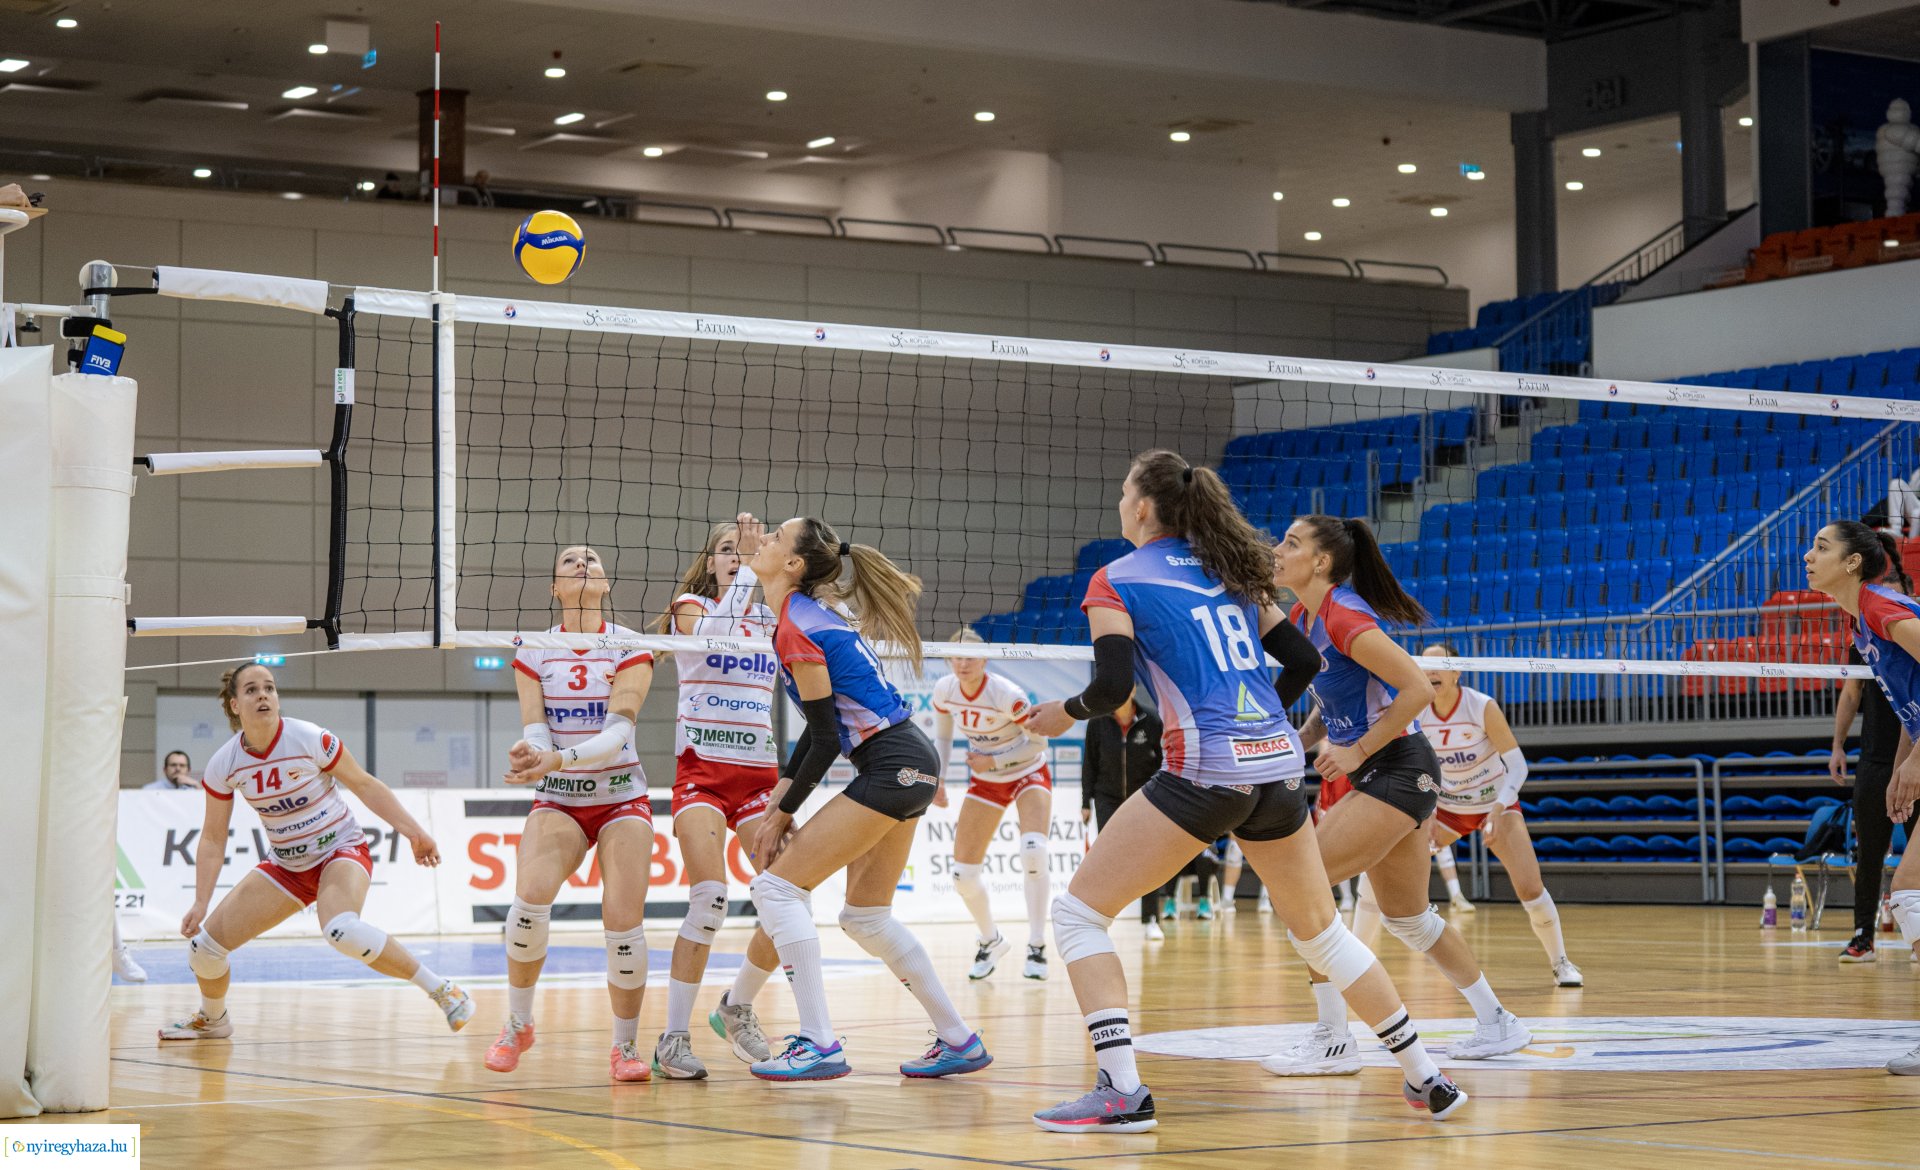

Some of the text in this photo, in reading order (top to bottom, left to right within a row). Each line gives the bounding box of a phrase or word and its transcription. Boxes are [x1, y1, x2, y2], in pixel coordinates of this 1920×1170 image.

[991, 340, 1029, 356] FATUM
[90, 354, 111, 368] FIVB
[1267, 360, 1303, 376] FATUM
[1190, 604, 1260, 673] 18
[706, 653, 776, 675] apollo
[567, 664, 588, 691] 3
[545, 702, 608, 723] apoll
[960, 709, 981, 728] 17
[1439, 729, 1451, 746] 7
[1233, 738, 1290, 756] STRABAG
[252, 767, 282, 794] 14
[126, 894, 145, 909] 21
